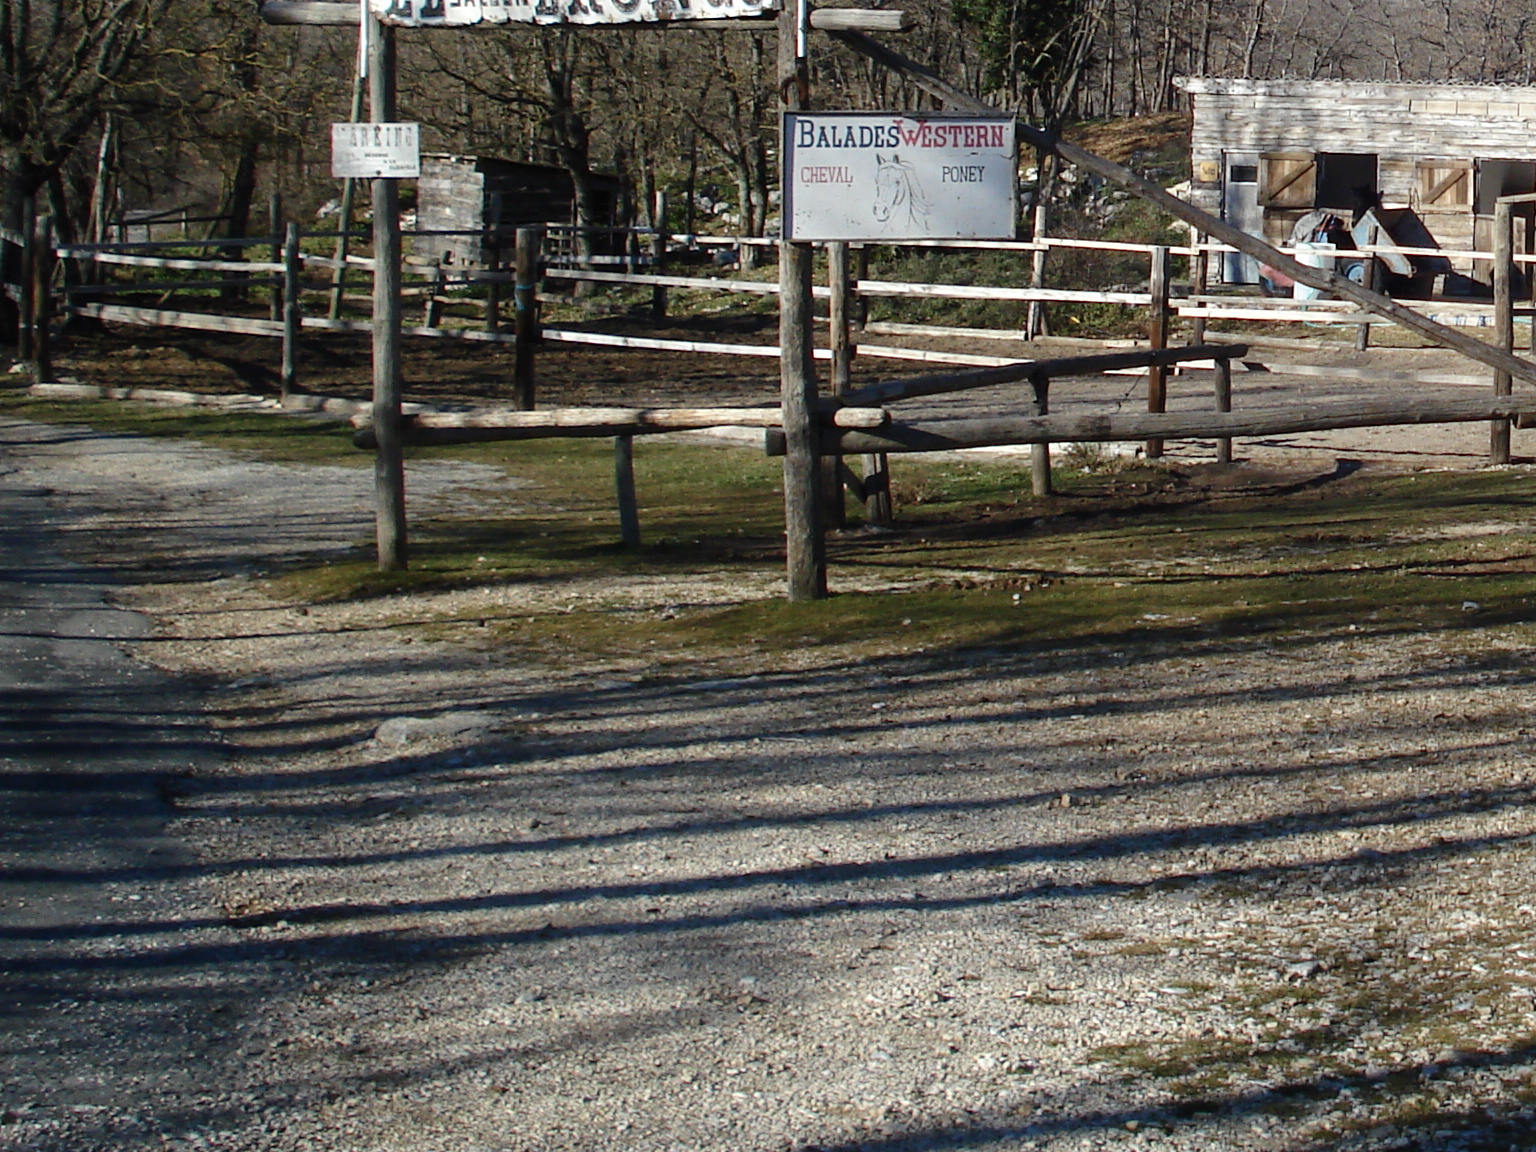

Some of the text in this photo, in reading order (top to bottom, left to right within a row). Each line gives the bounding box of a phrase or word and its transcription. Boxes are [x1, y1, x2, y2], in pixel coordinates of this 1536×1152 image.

[335, 127, 412, 147] ARKING
[797, 119, 1005, 148] BALADES WESTERN
[800, 165, 986, 183] CHEVAL PONEY
